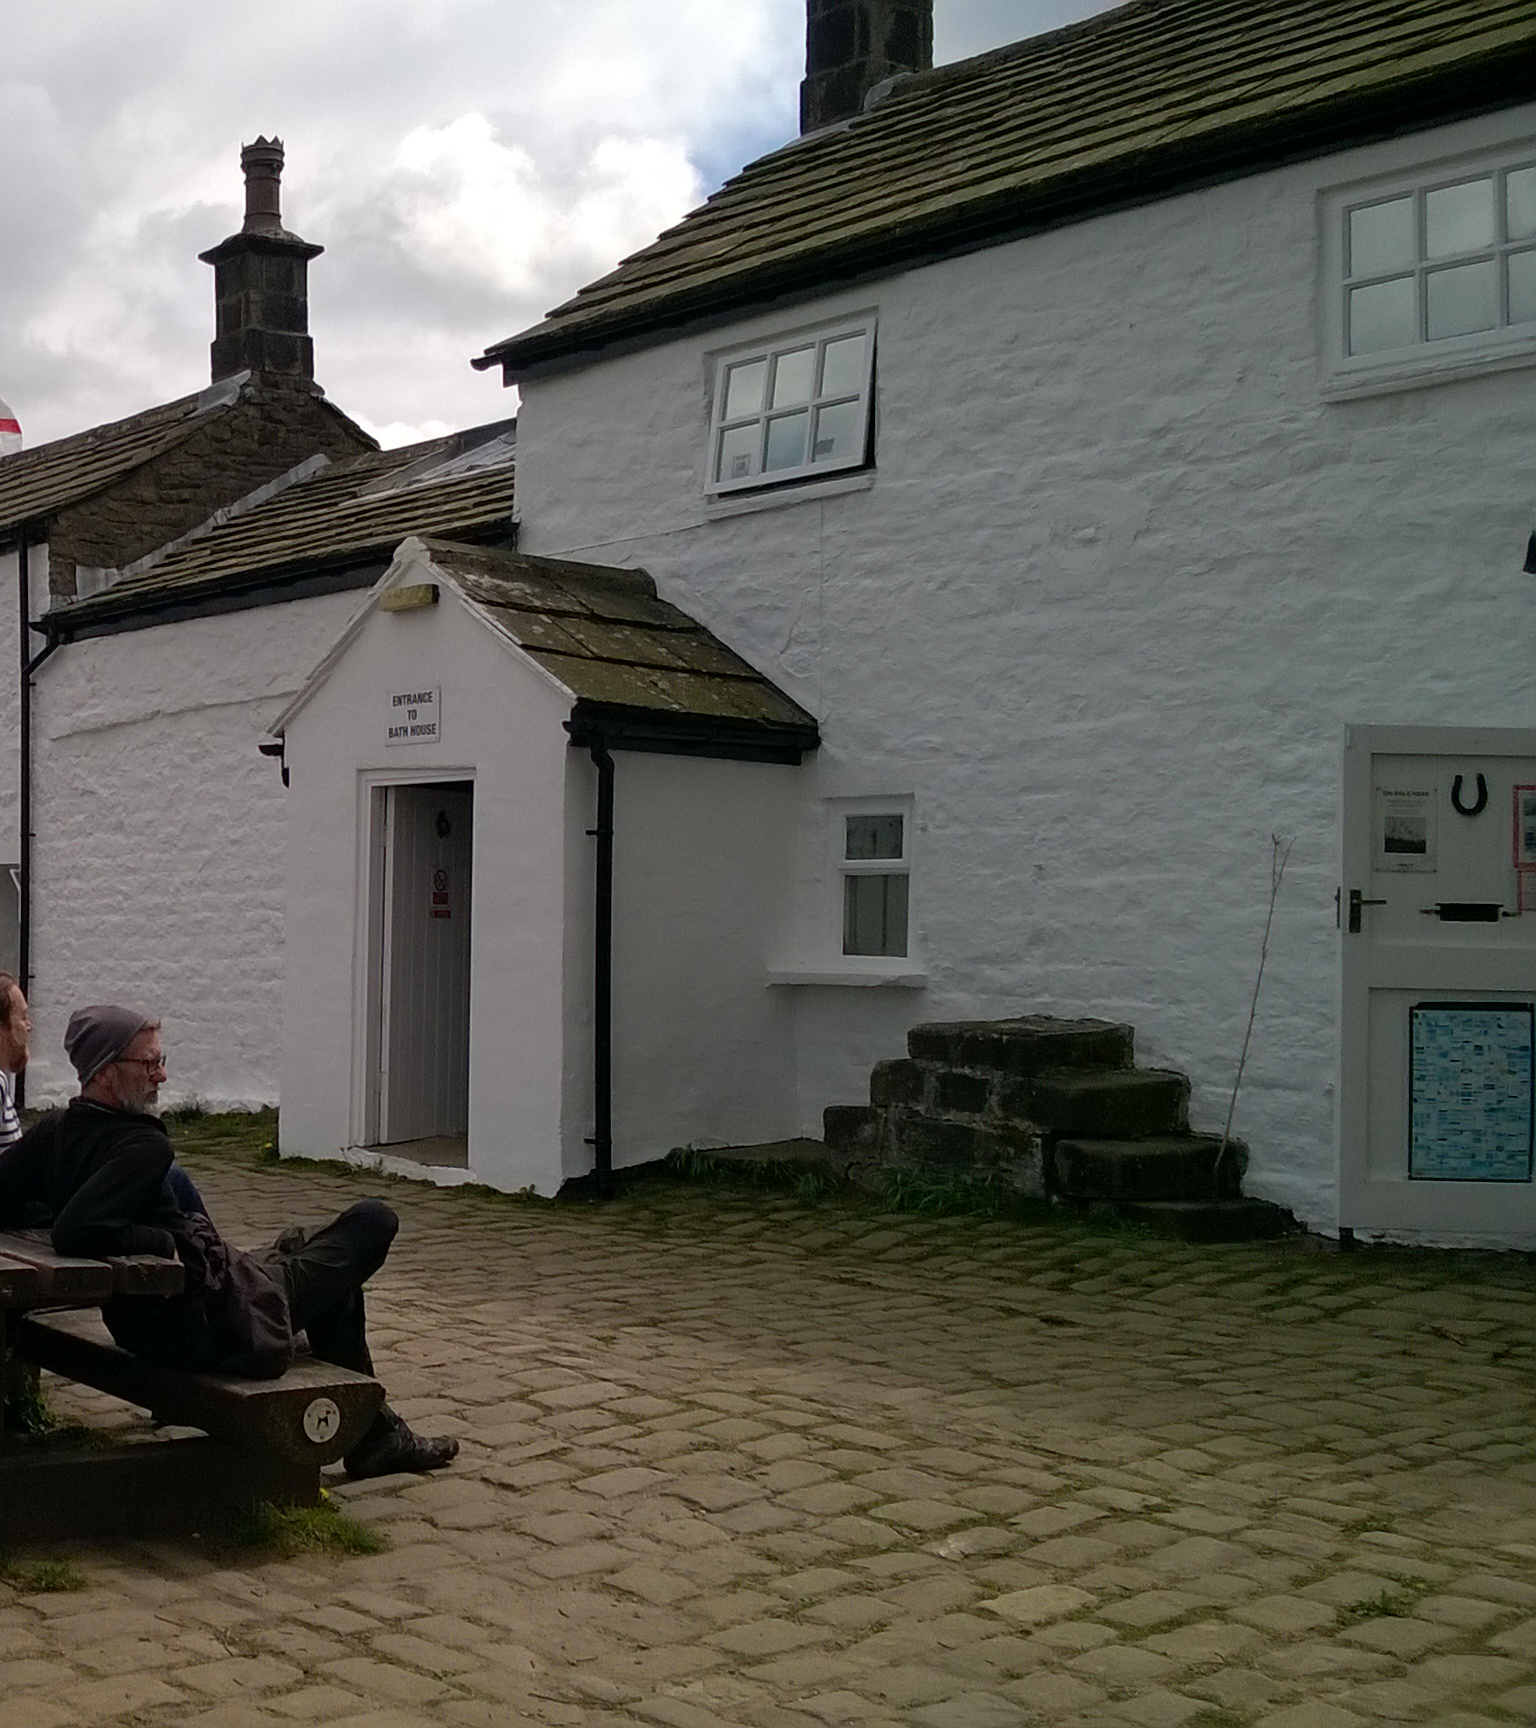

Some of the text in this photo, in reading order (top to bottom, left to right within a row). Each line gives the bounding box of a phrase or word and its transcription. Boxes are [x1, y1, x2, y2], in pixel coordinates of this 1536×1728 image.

[392, 691, 433, 707] ENTRANCE
[407, 709, 417, 721] TO
[388, 723, 437, 739] BATH HOUSE
